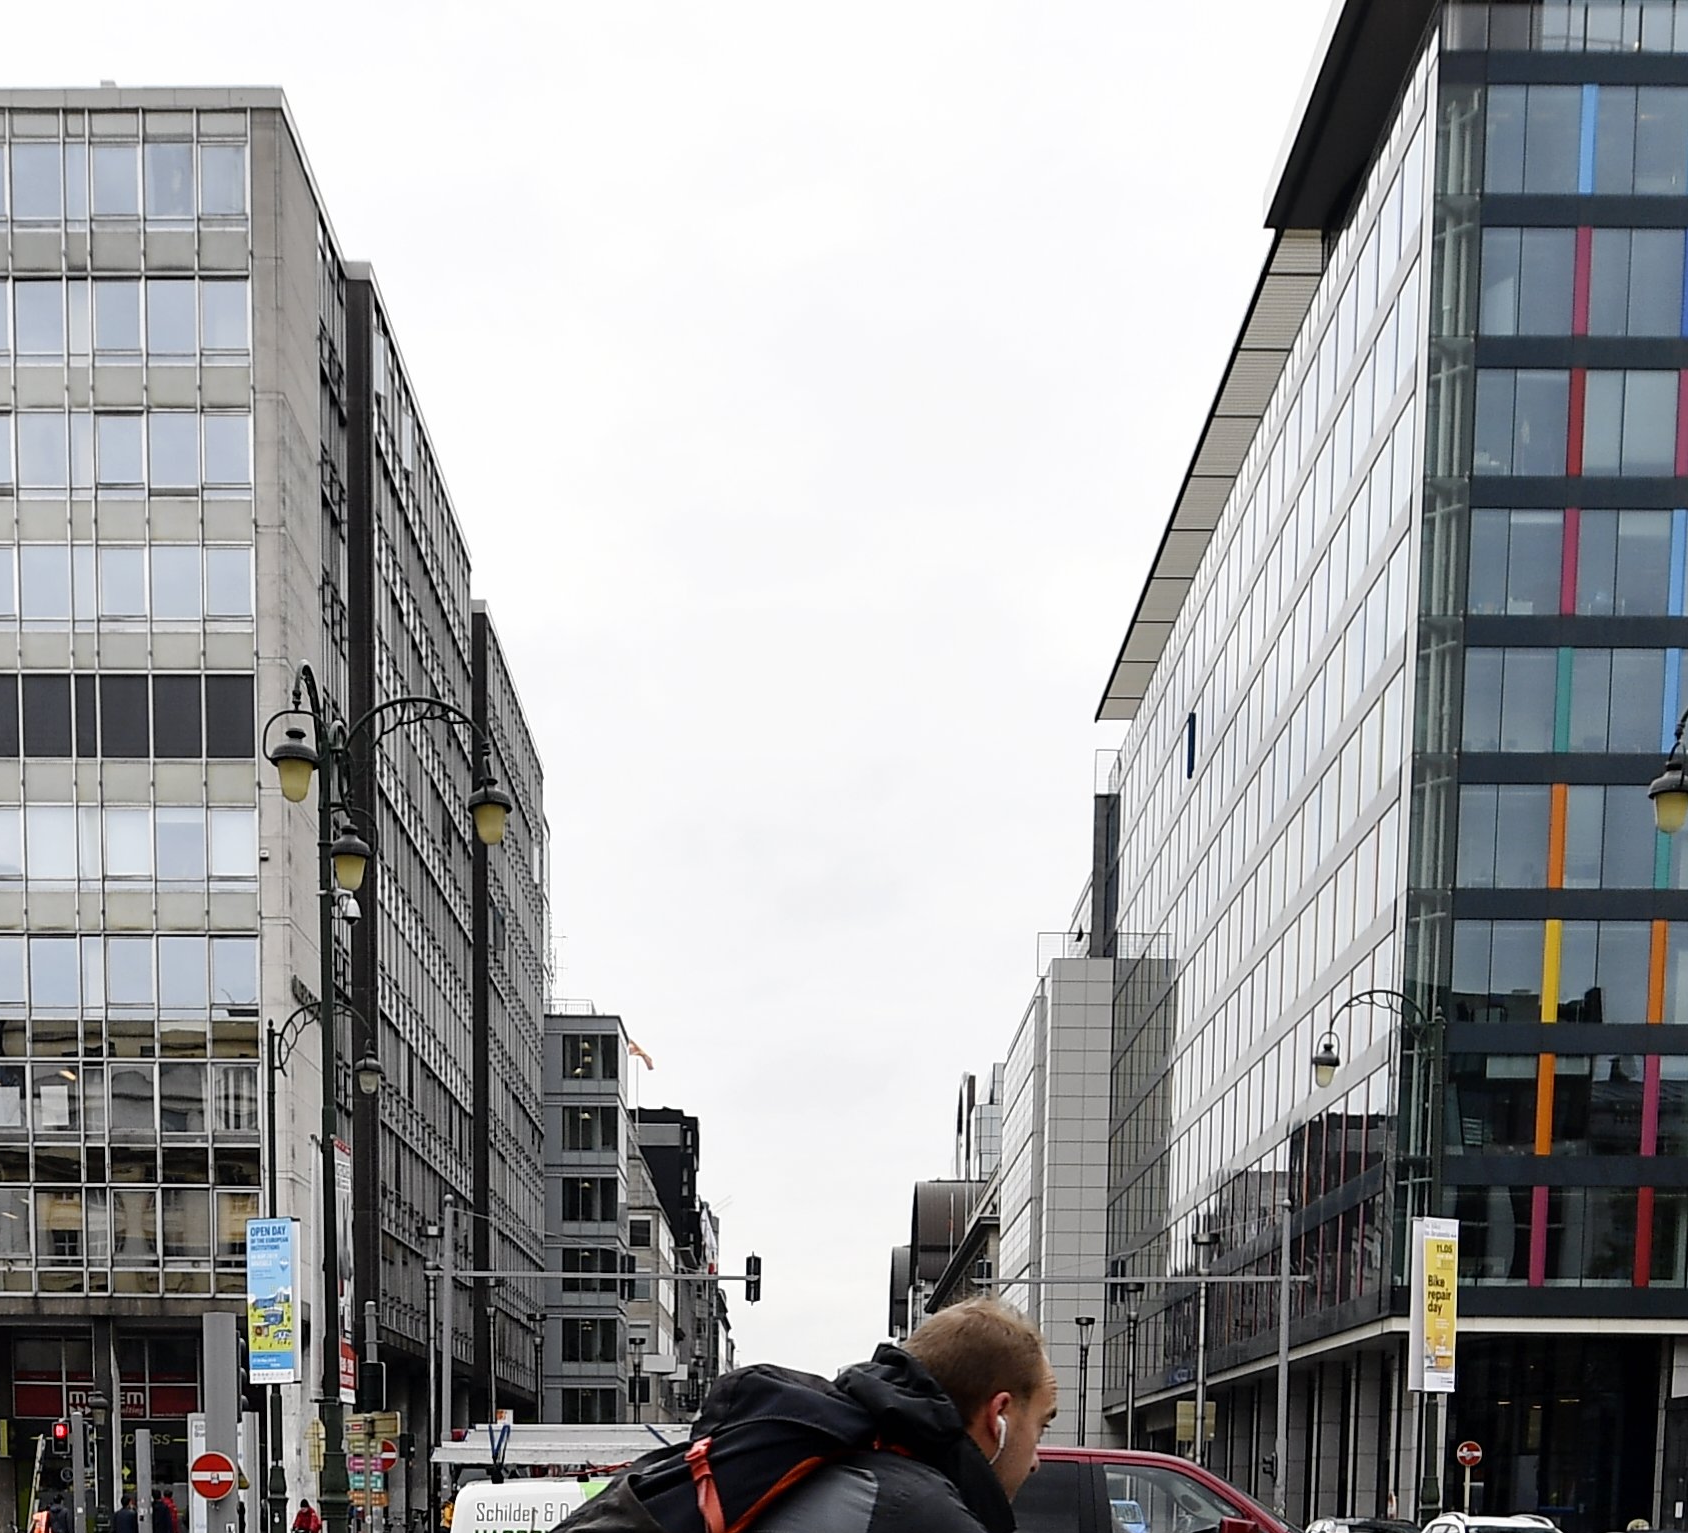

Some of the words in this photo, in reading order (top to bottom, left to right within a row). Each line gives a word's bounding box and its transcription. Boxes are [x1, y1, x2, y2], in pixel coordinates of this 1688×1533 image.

[250, 1226, 270, 1237] OPEN
[272, 1225, 286, 1236] DAY
[1428, 1274, 1445, 1288] Bike
[1428, 1288, 1452, 1303] repair
[1428, 1301, 1442, 1316] day
[476, 1502, 538, 1522] Schilder
[544, 1502, 554, 1522] &
